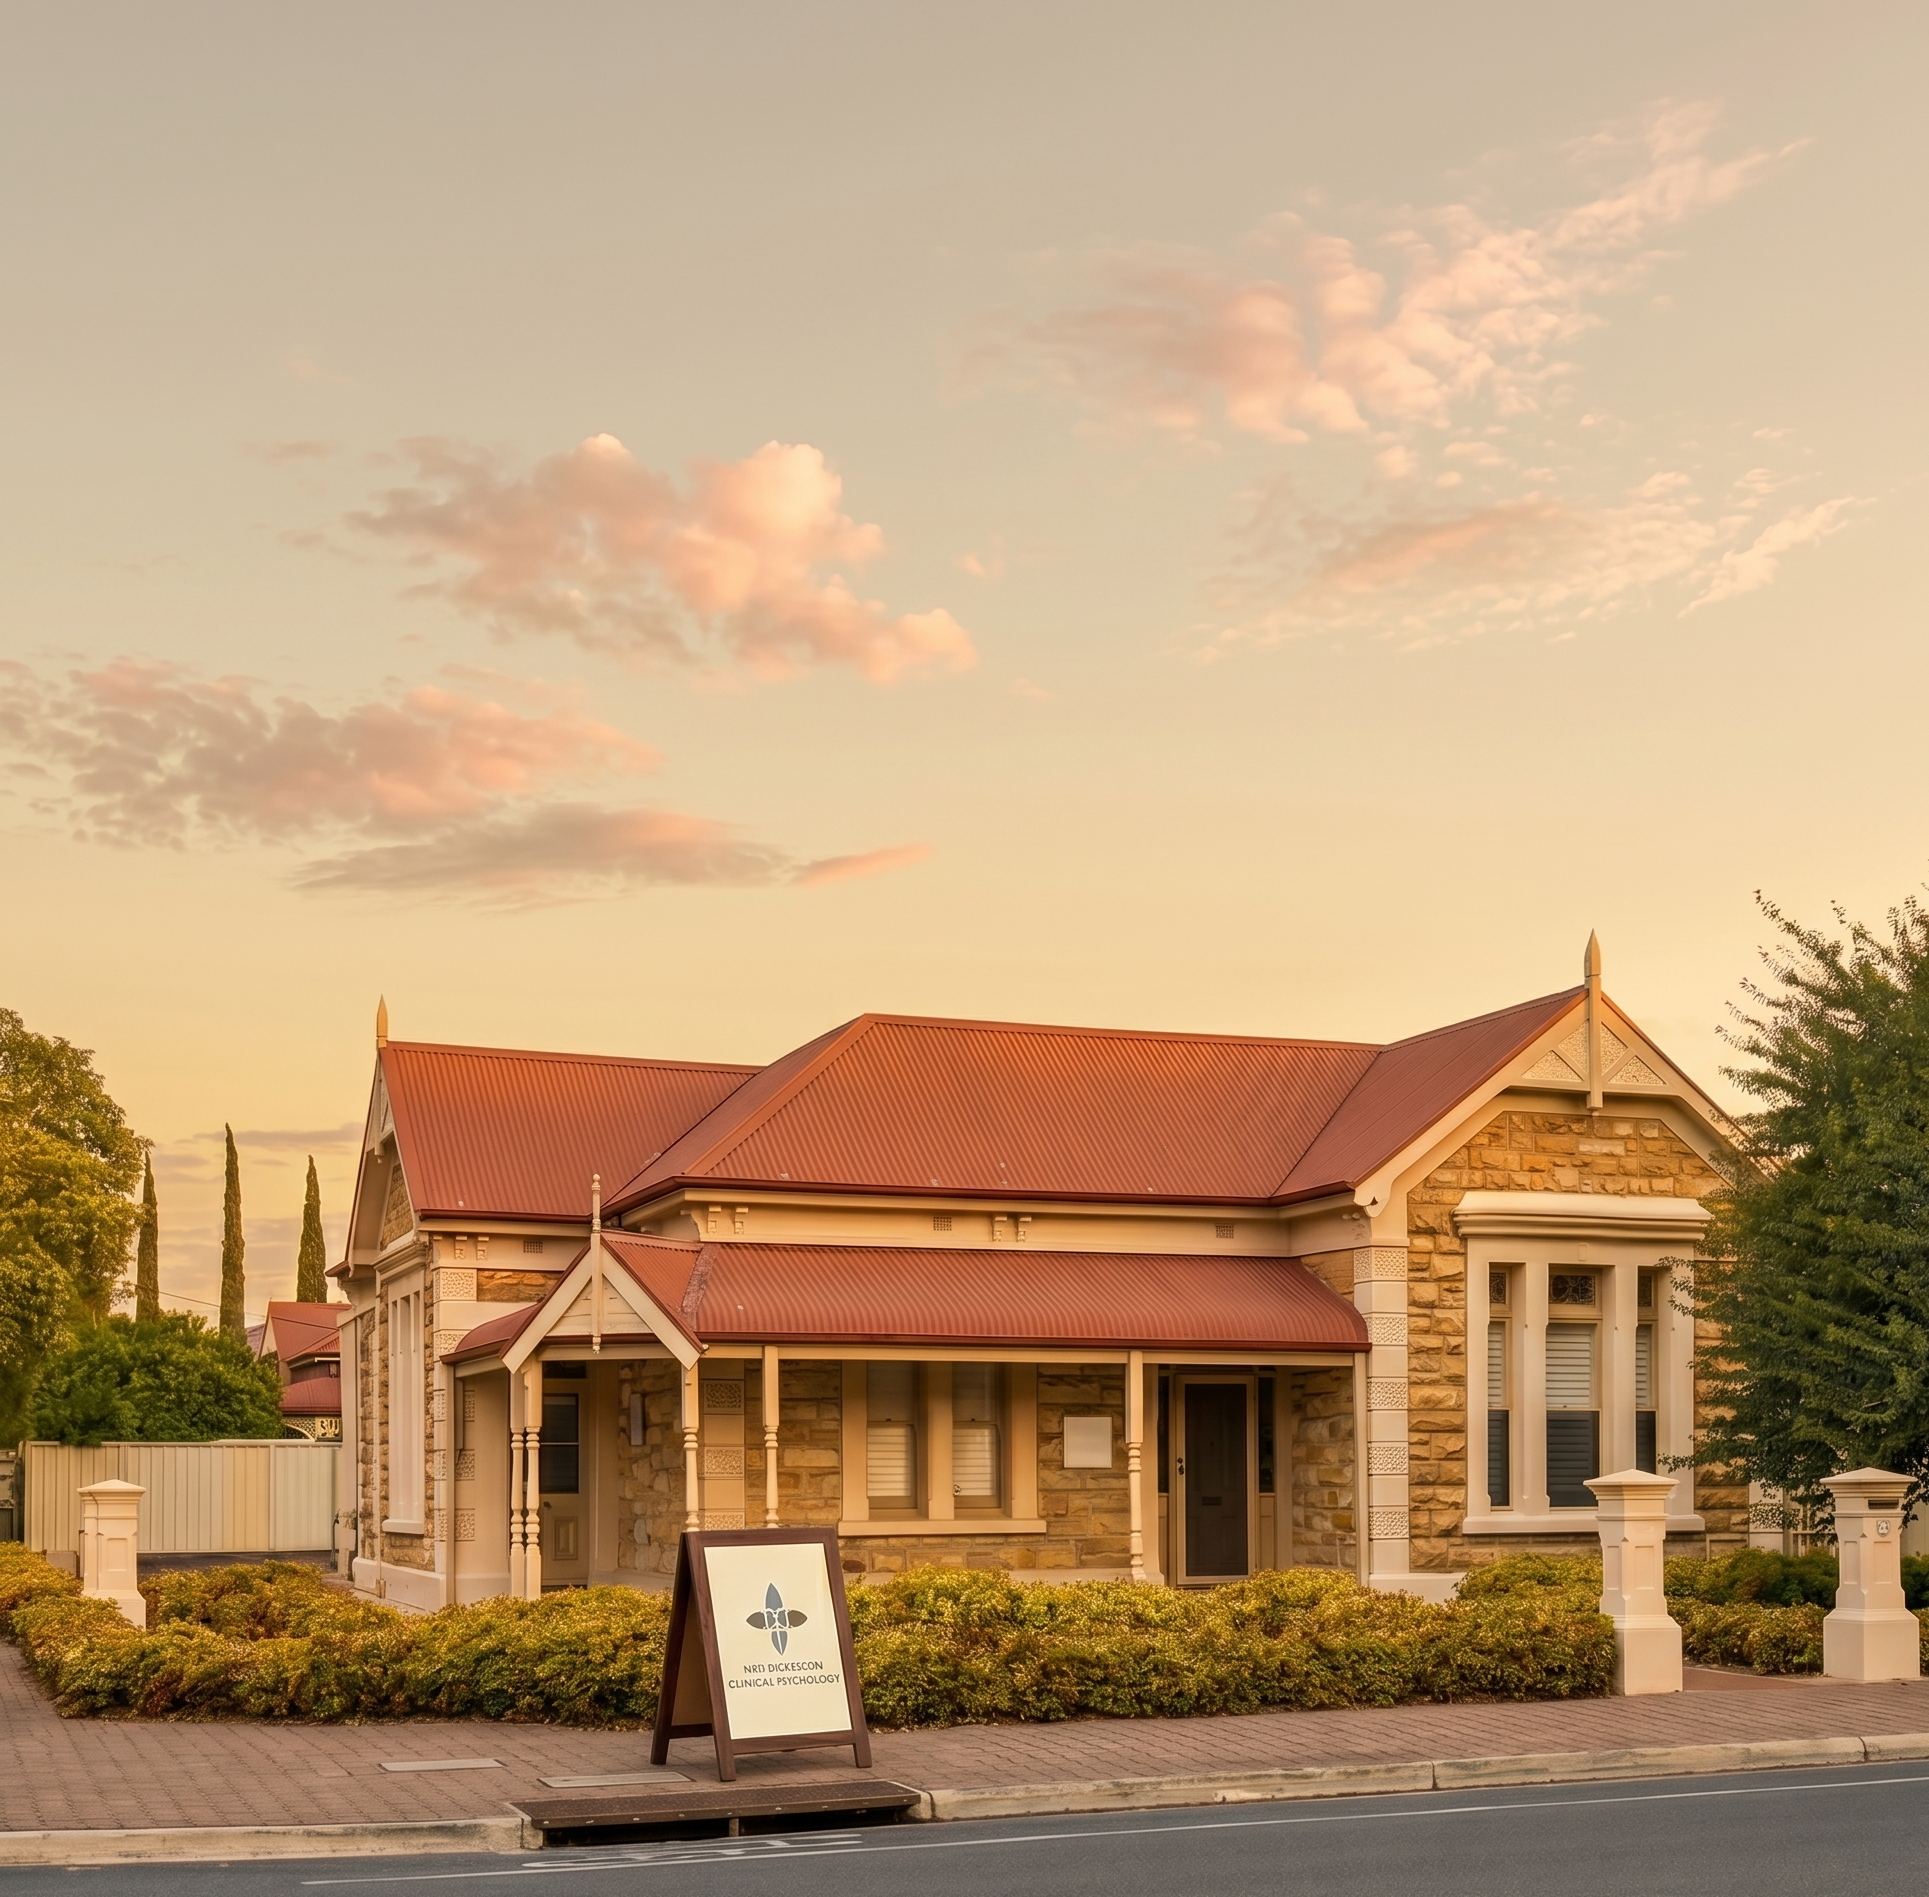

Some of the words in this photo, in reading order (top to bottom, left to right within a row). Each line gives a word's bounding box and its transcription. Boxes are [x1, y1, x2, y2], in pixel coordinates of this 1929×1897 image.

[767, 1661, 823, 1673] DICKESCON
[728, 1677, 774, 1689] CLINICAL
[777, 1674, 840, 1686] PSYCHOLOGY
